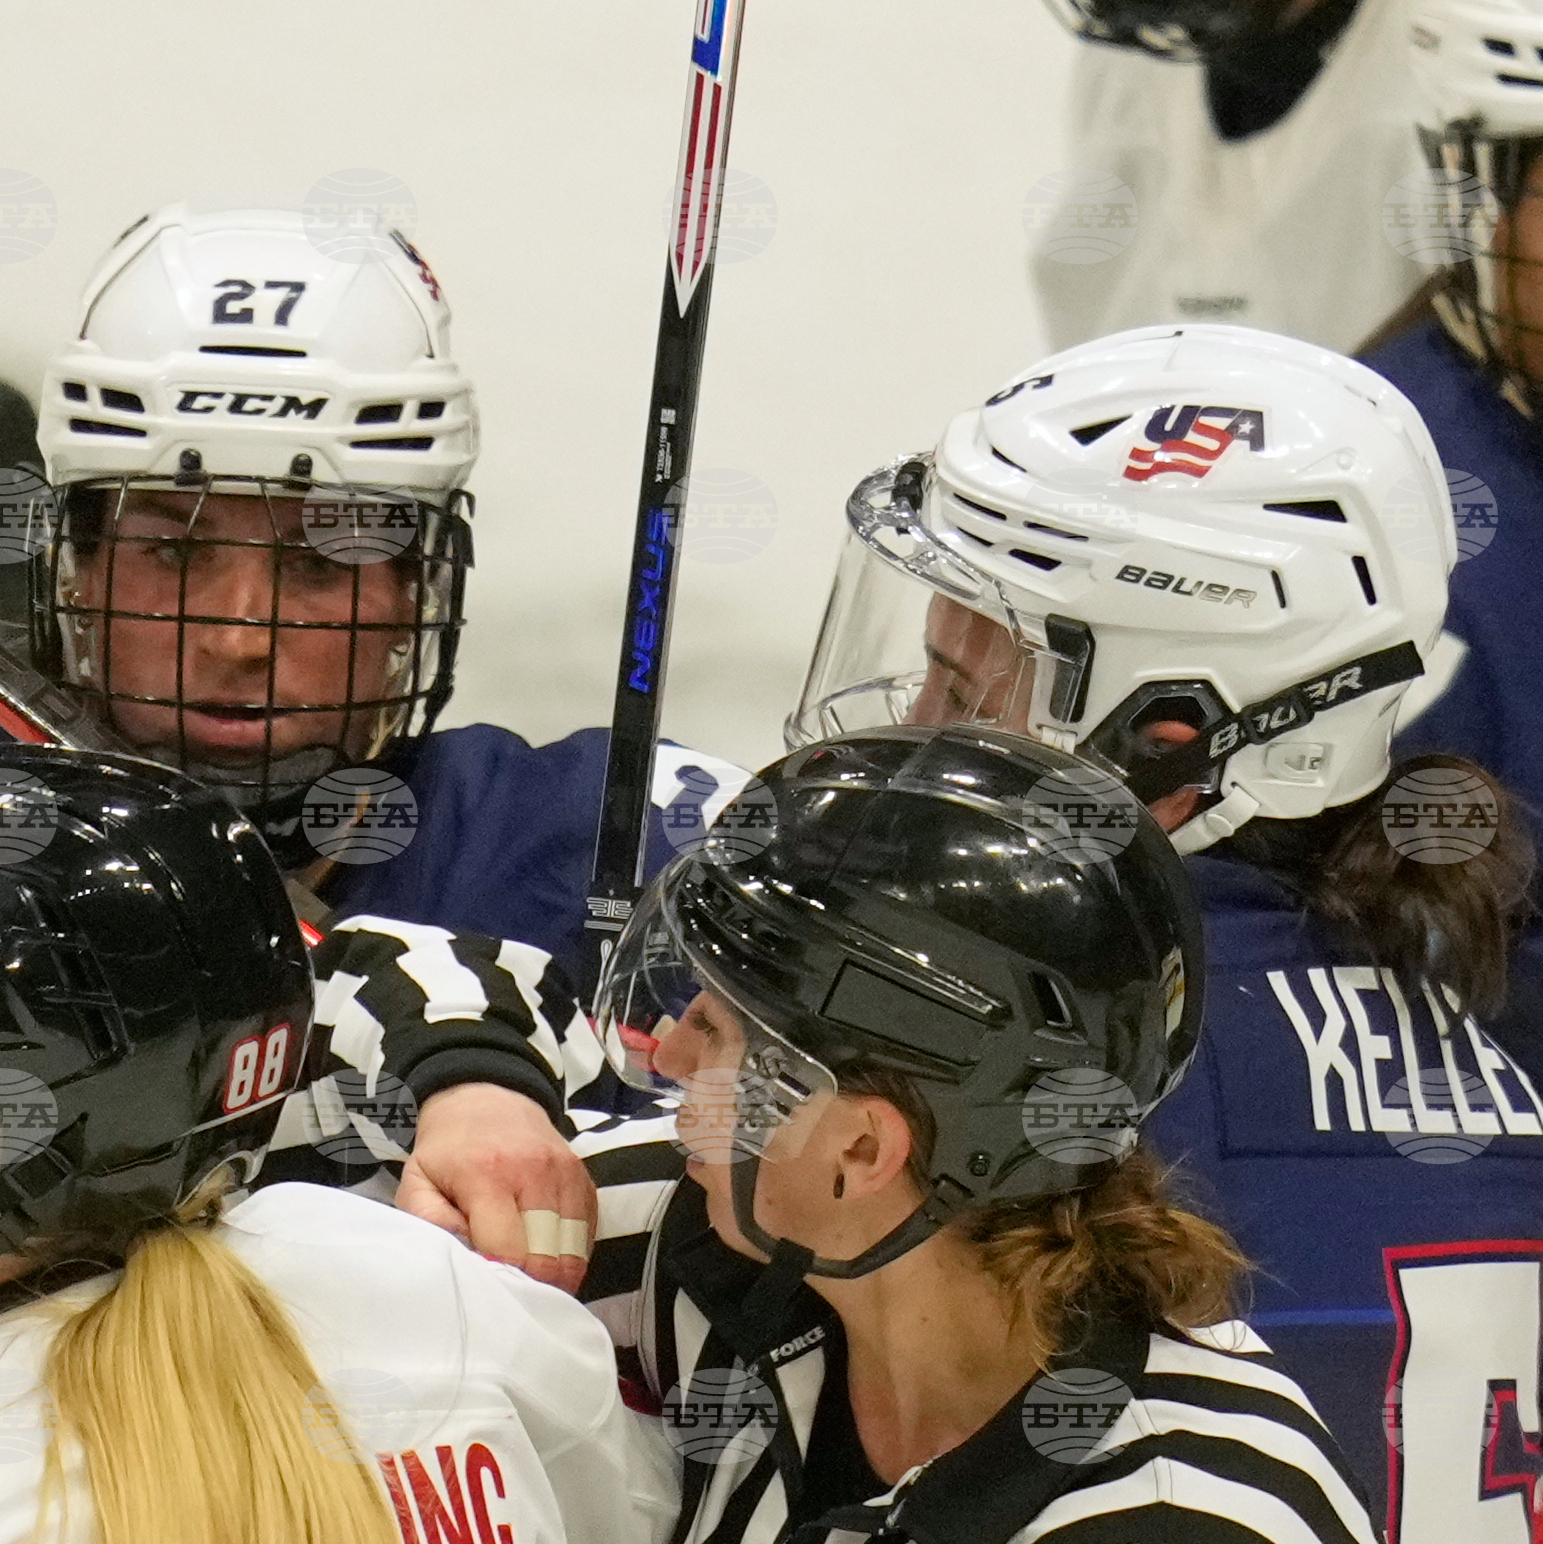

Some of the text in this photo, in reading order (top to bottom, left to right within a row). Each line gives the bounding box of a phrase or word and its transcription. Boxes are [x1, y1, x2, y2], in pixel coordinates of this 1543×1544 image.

[211, 278, 308, 327] 27
[175, 389, 331, 421] CCM
[1123, 403, 1267, 483] USA
[628, 507, 671, 693] NEXUS
[222, 1022, 291, 1115] 88
[769, 1325, 827, 1363] FORCE
